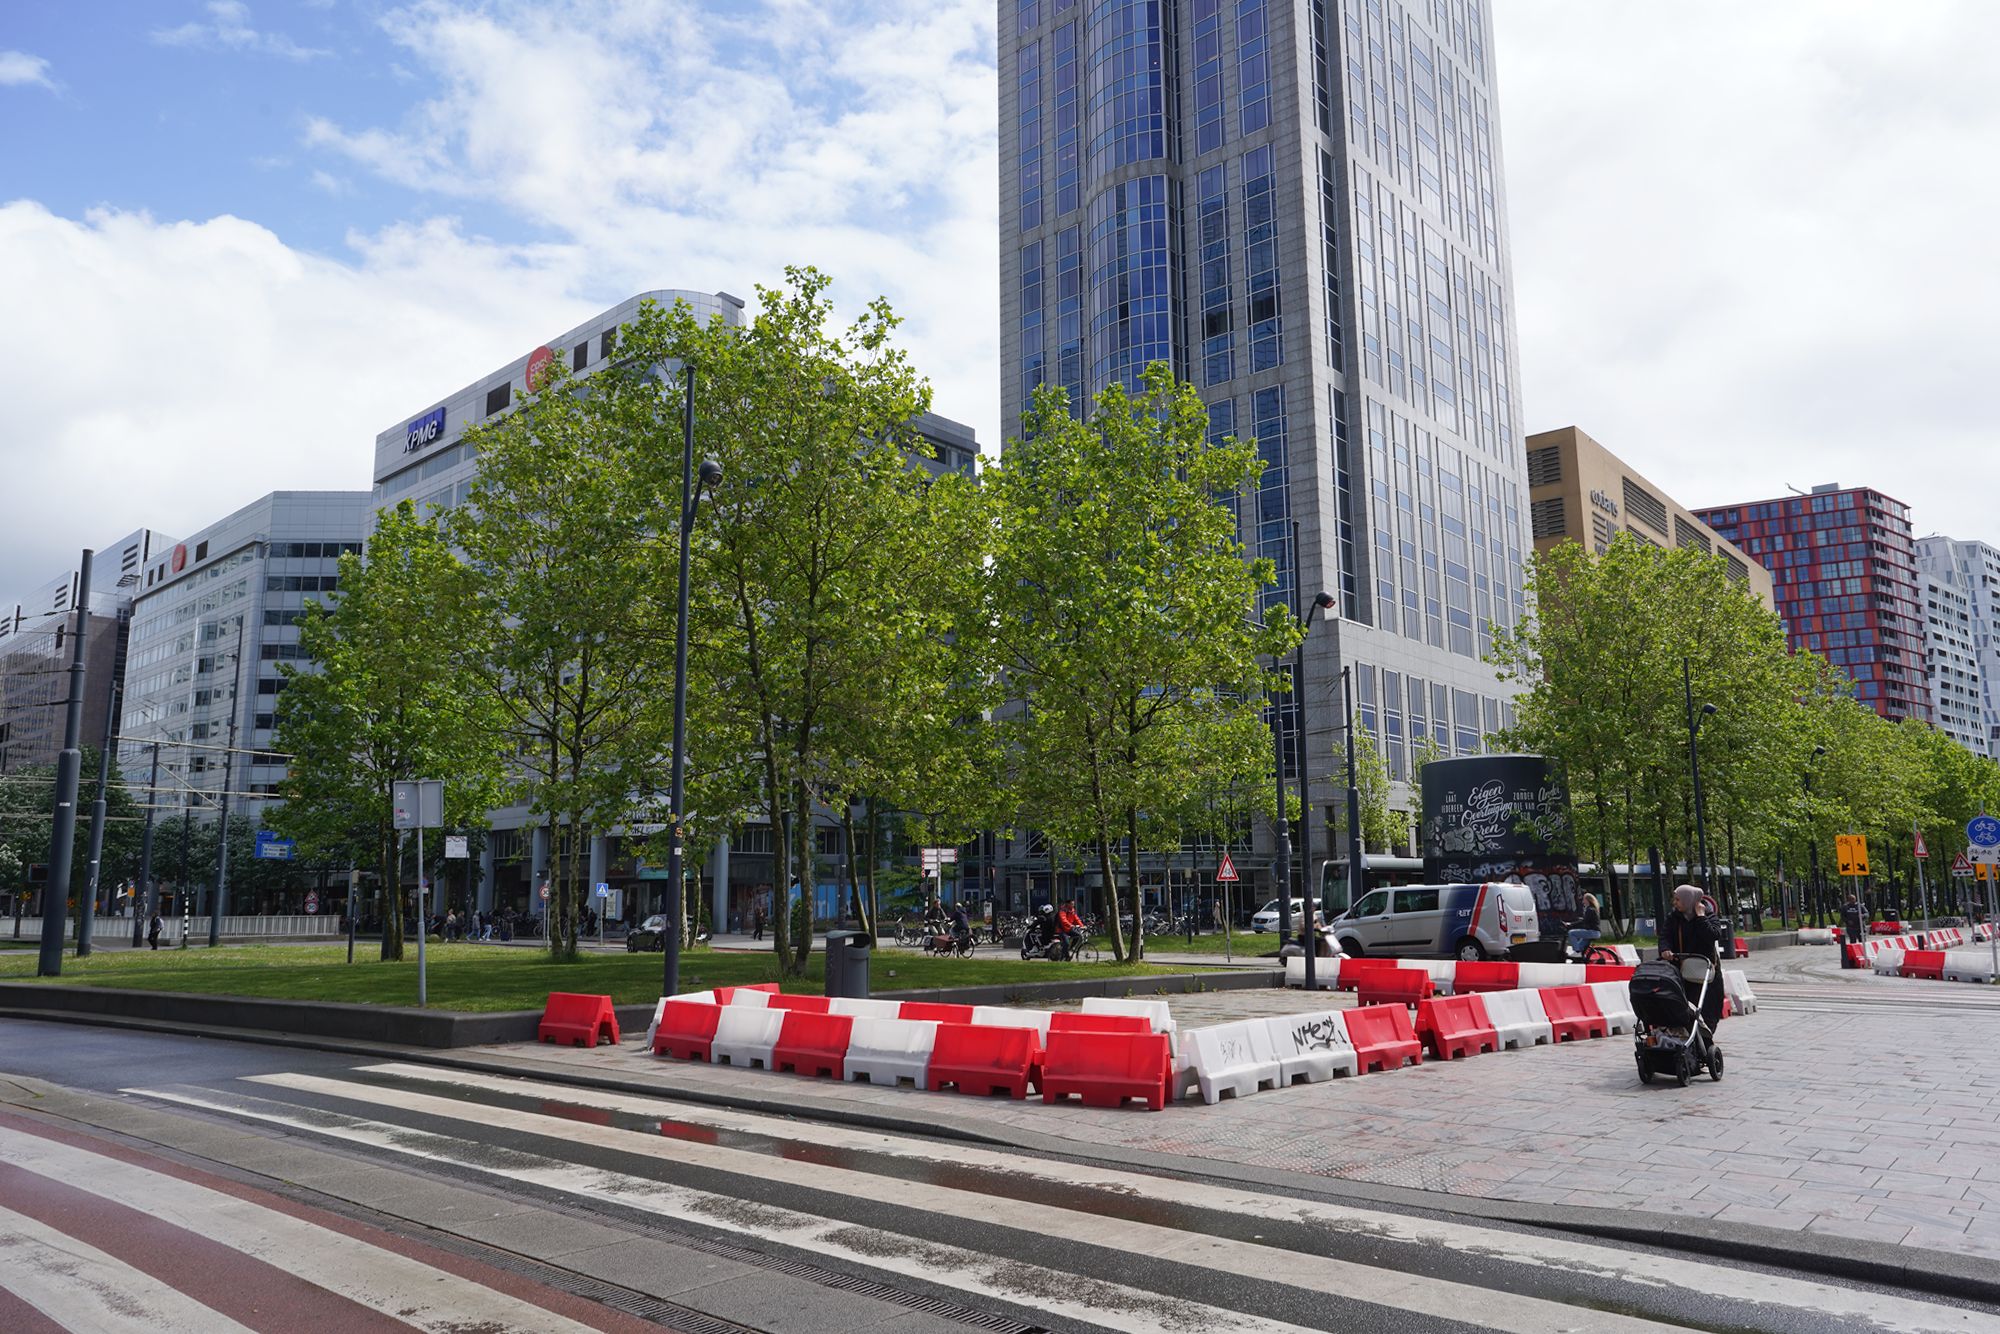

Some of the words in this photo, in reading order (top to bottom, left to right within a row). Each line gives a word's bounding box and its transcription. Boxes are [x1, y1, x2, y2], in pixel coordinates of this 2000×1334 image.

[403, 420, 438, 454] KPMG
[1445, 794, 1457, 803] LAAT
[1467, 779, 1505, 809] Eigen
[1513, 791, 1534, 801] ZONDER
[1441, 804, 1463, 813] IEDEREEN
[1461, 796, 1514, 827] Overtuiging
[1525, 802, 1535, 811] VAN
